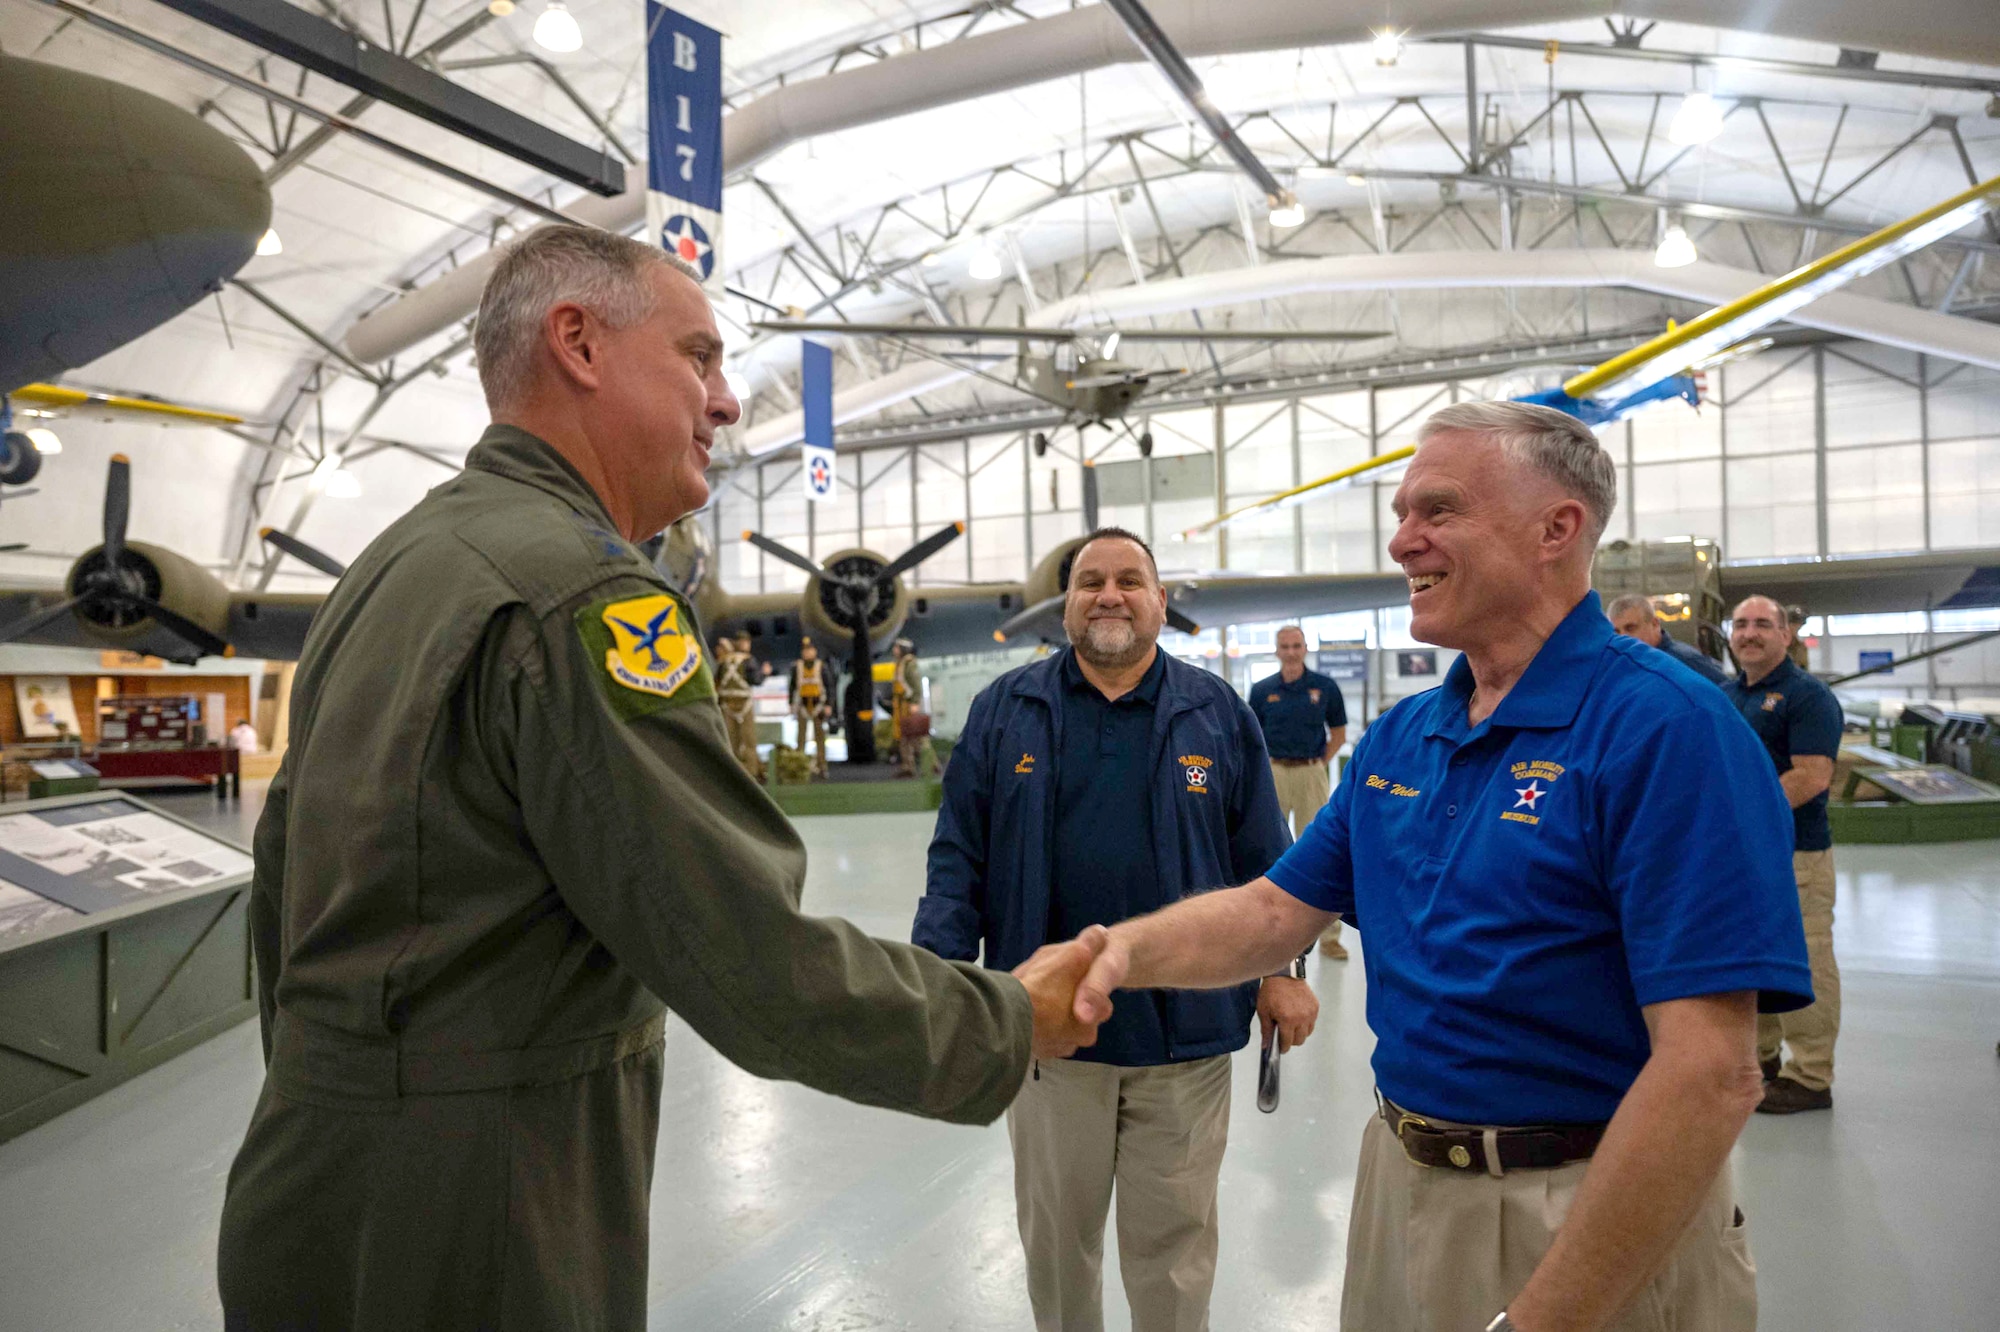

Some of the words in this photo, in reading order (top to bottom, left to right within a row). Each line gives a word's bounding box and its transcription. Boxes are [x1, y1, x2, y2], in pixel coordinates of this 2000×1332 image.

[1511, 761, 1527, 773] AIR
[1530, 760, 1566, 776] MOBILITY
[1514, 769, 1558, 782] COMMAND
[1365, 774, 1390, 790] Bill
[1500, 811, 1540, 825] MUSEUM
